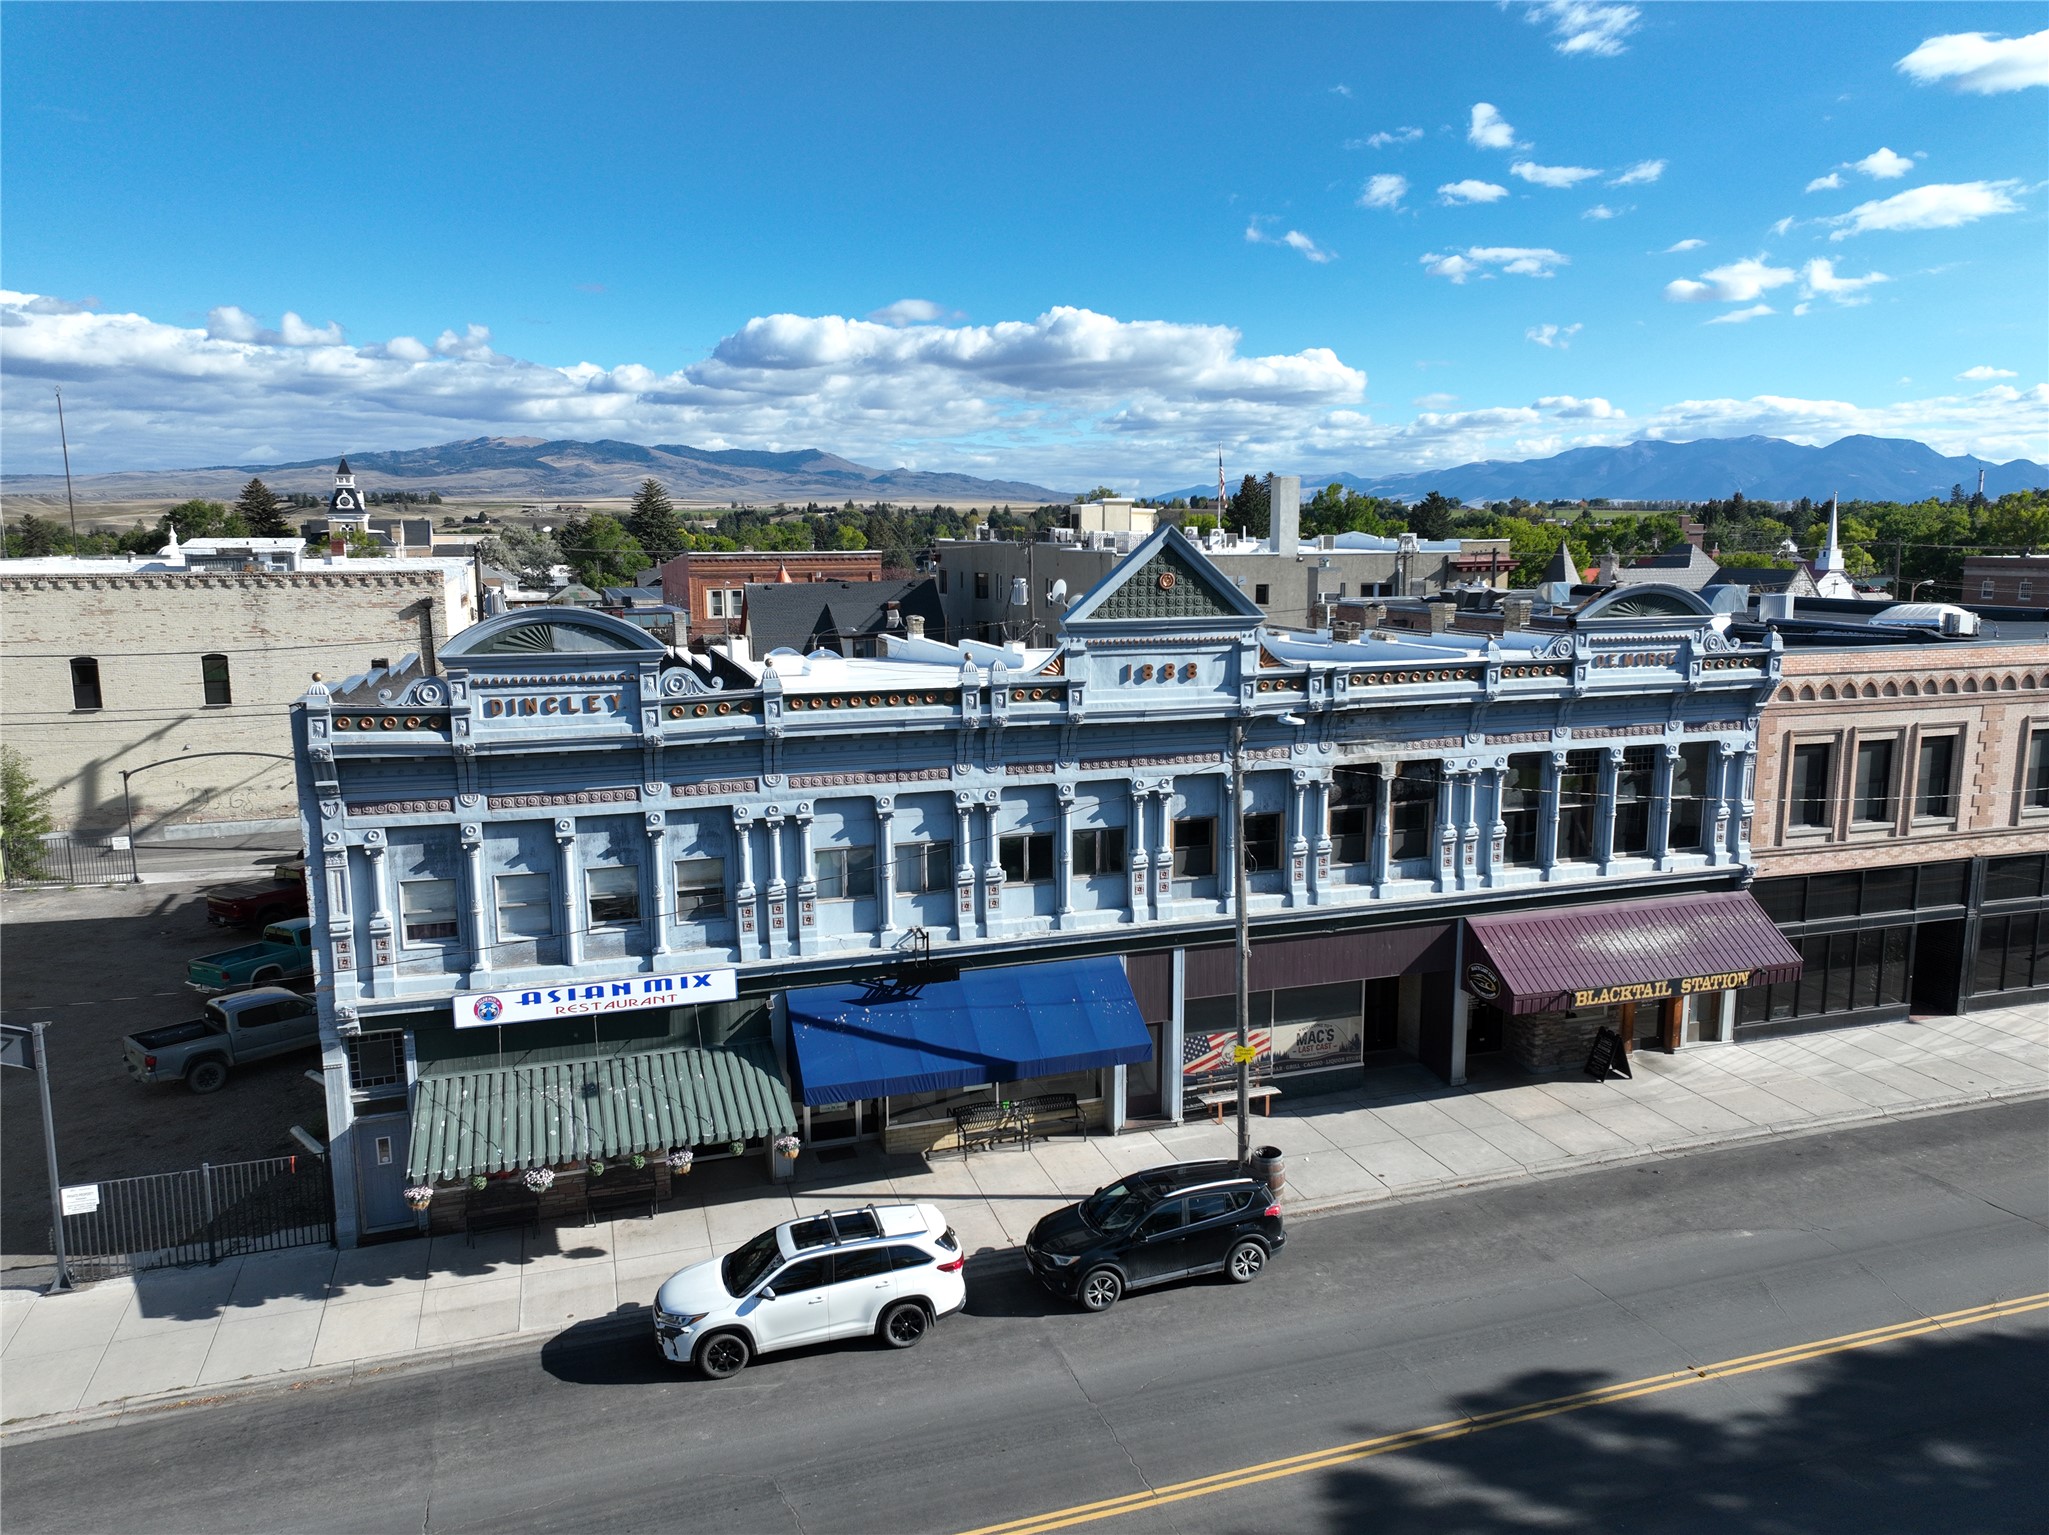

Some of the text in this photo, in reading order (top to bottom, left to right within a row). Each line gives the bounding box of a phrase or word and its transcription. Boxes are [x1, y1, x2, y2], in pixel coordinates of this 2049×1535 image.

[1625, 653, 1677, 668] MORSE
[1127, 663, 1198, 680] 1888
[515, 981, 631, 1006] ASIAN
[643, 973, 712, 993] MIX
[1575, 971, 1750, 1007] BLACKTAIL STATION
[555, 994, 678, 1015] RESTAURANT
[1297, 1029, 1335, 1047] MAC'S
[1299, 1045, 1314, 1054] LAST
[1315, 1042, 1332, 1051] CAST
